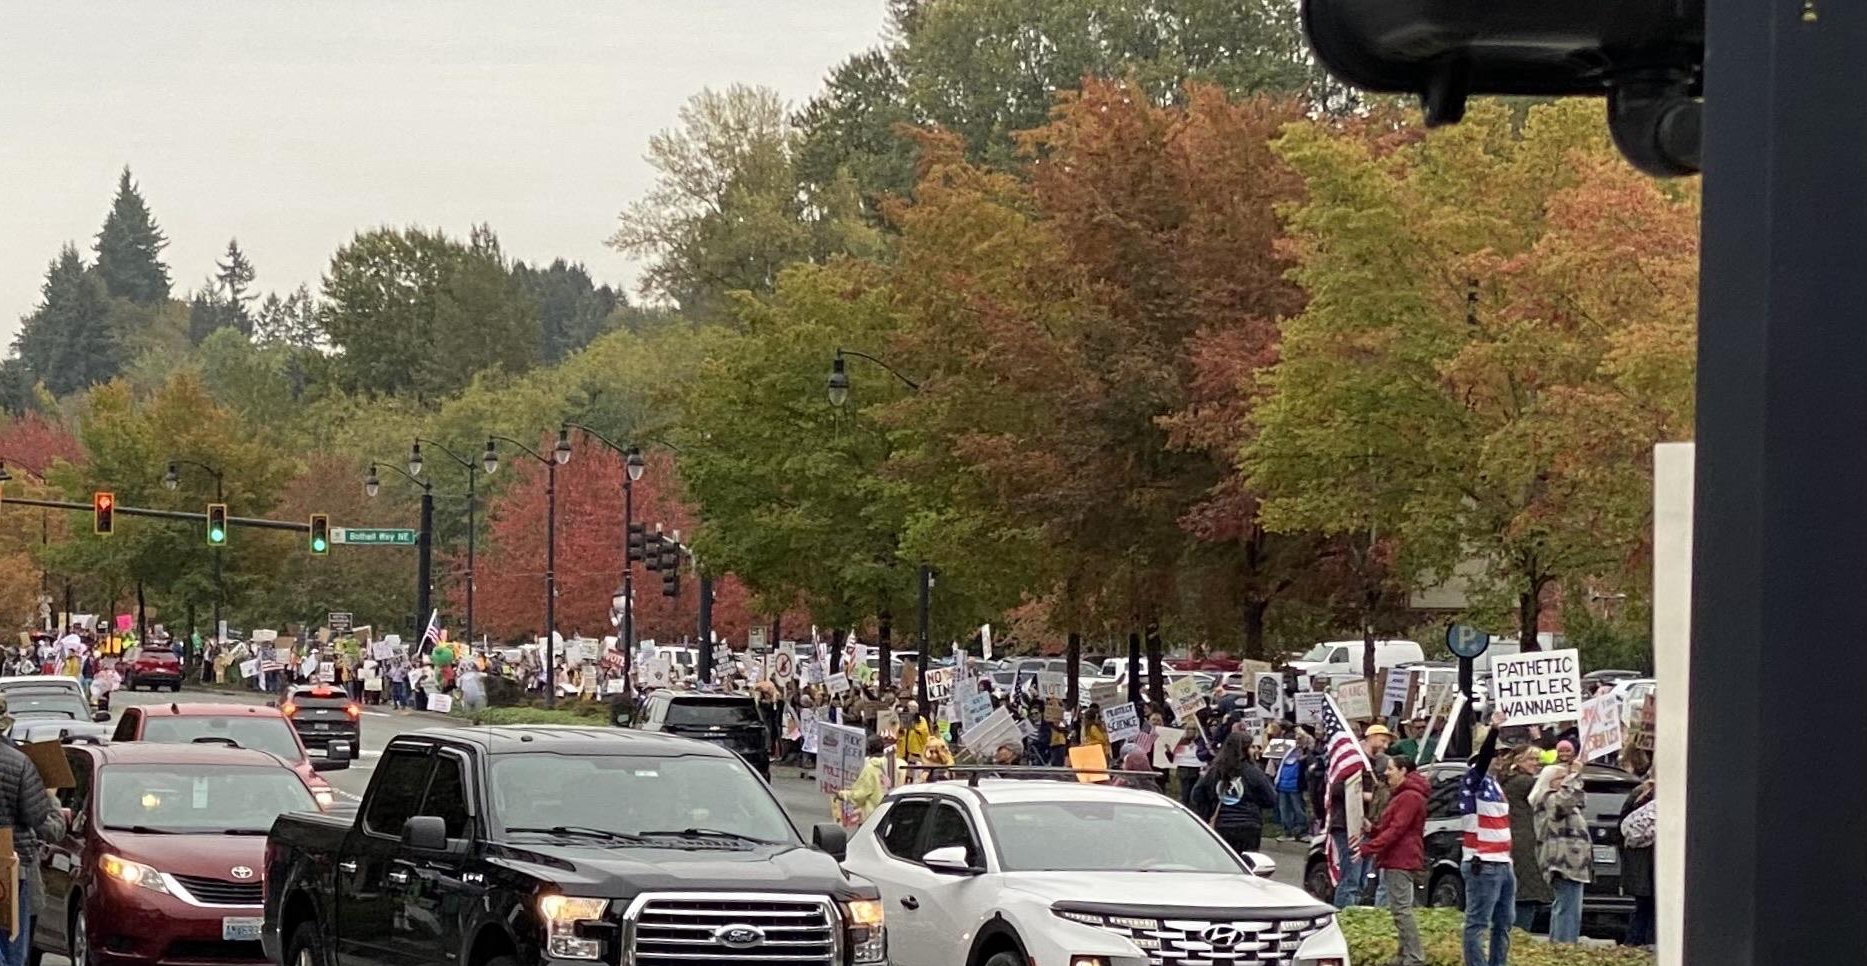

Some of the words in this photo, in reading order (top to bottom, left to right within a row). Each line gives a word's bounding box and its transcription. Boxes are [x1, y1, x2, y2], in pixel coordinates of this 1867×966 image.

[349, 532, 376, 541] Bothell
[379, 532, 395, 542] Way
[398, 532, 409, 541] NE
[1497, 657, 1573, 679] PATHETIC
[927, 671, 942, 684] NO
[929, 683, 952, 699] KIN
[1499, 678, 1573, 698] HITLER
[1501, 696, 1578, 718] WANNABE
